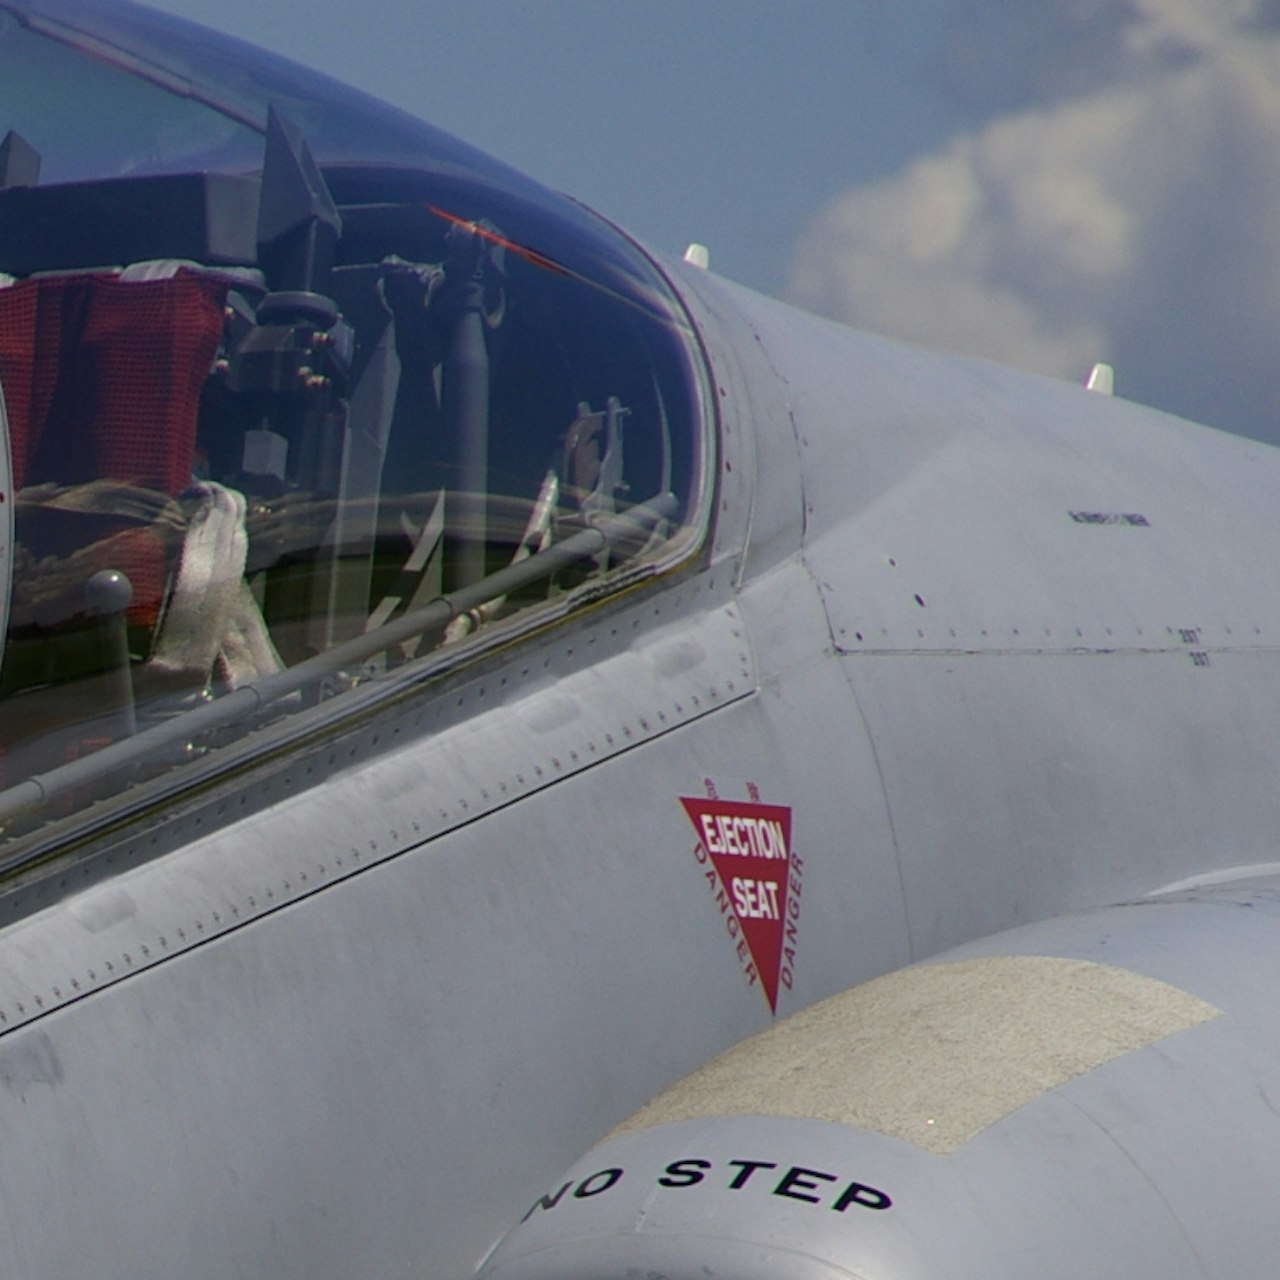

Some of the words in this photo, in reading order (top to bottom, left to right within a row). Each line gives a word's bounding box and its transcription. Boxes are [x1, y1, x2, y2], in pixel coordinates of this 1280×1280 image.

[699, 813, 788, 861] EJECTION
[693, 842, 759, 987] DANGER
[731, 876, 781, 921] SEAT
[780, 852, 805, 991] DANGER
[520, 1168, 624, 1224] NO
[657, 1159, 893, 1213] STEP
